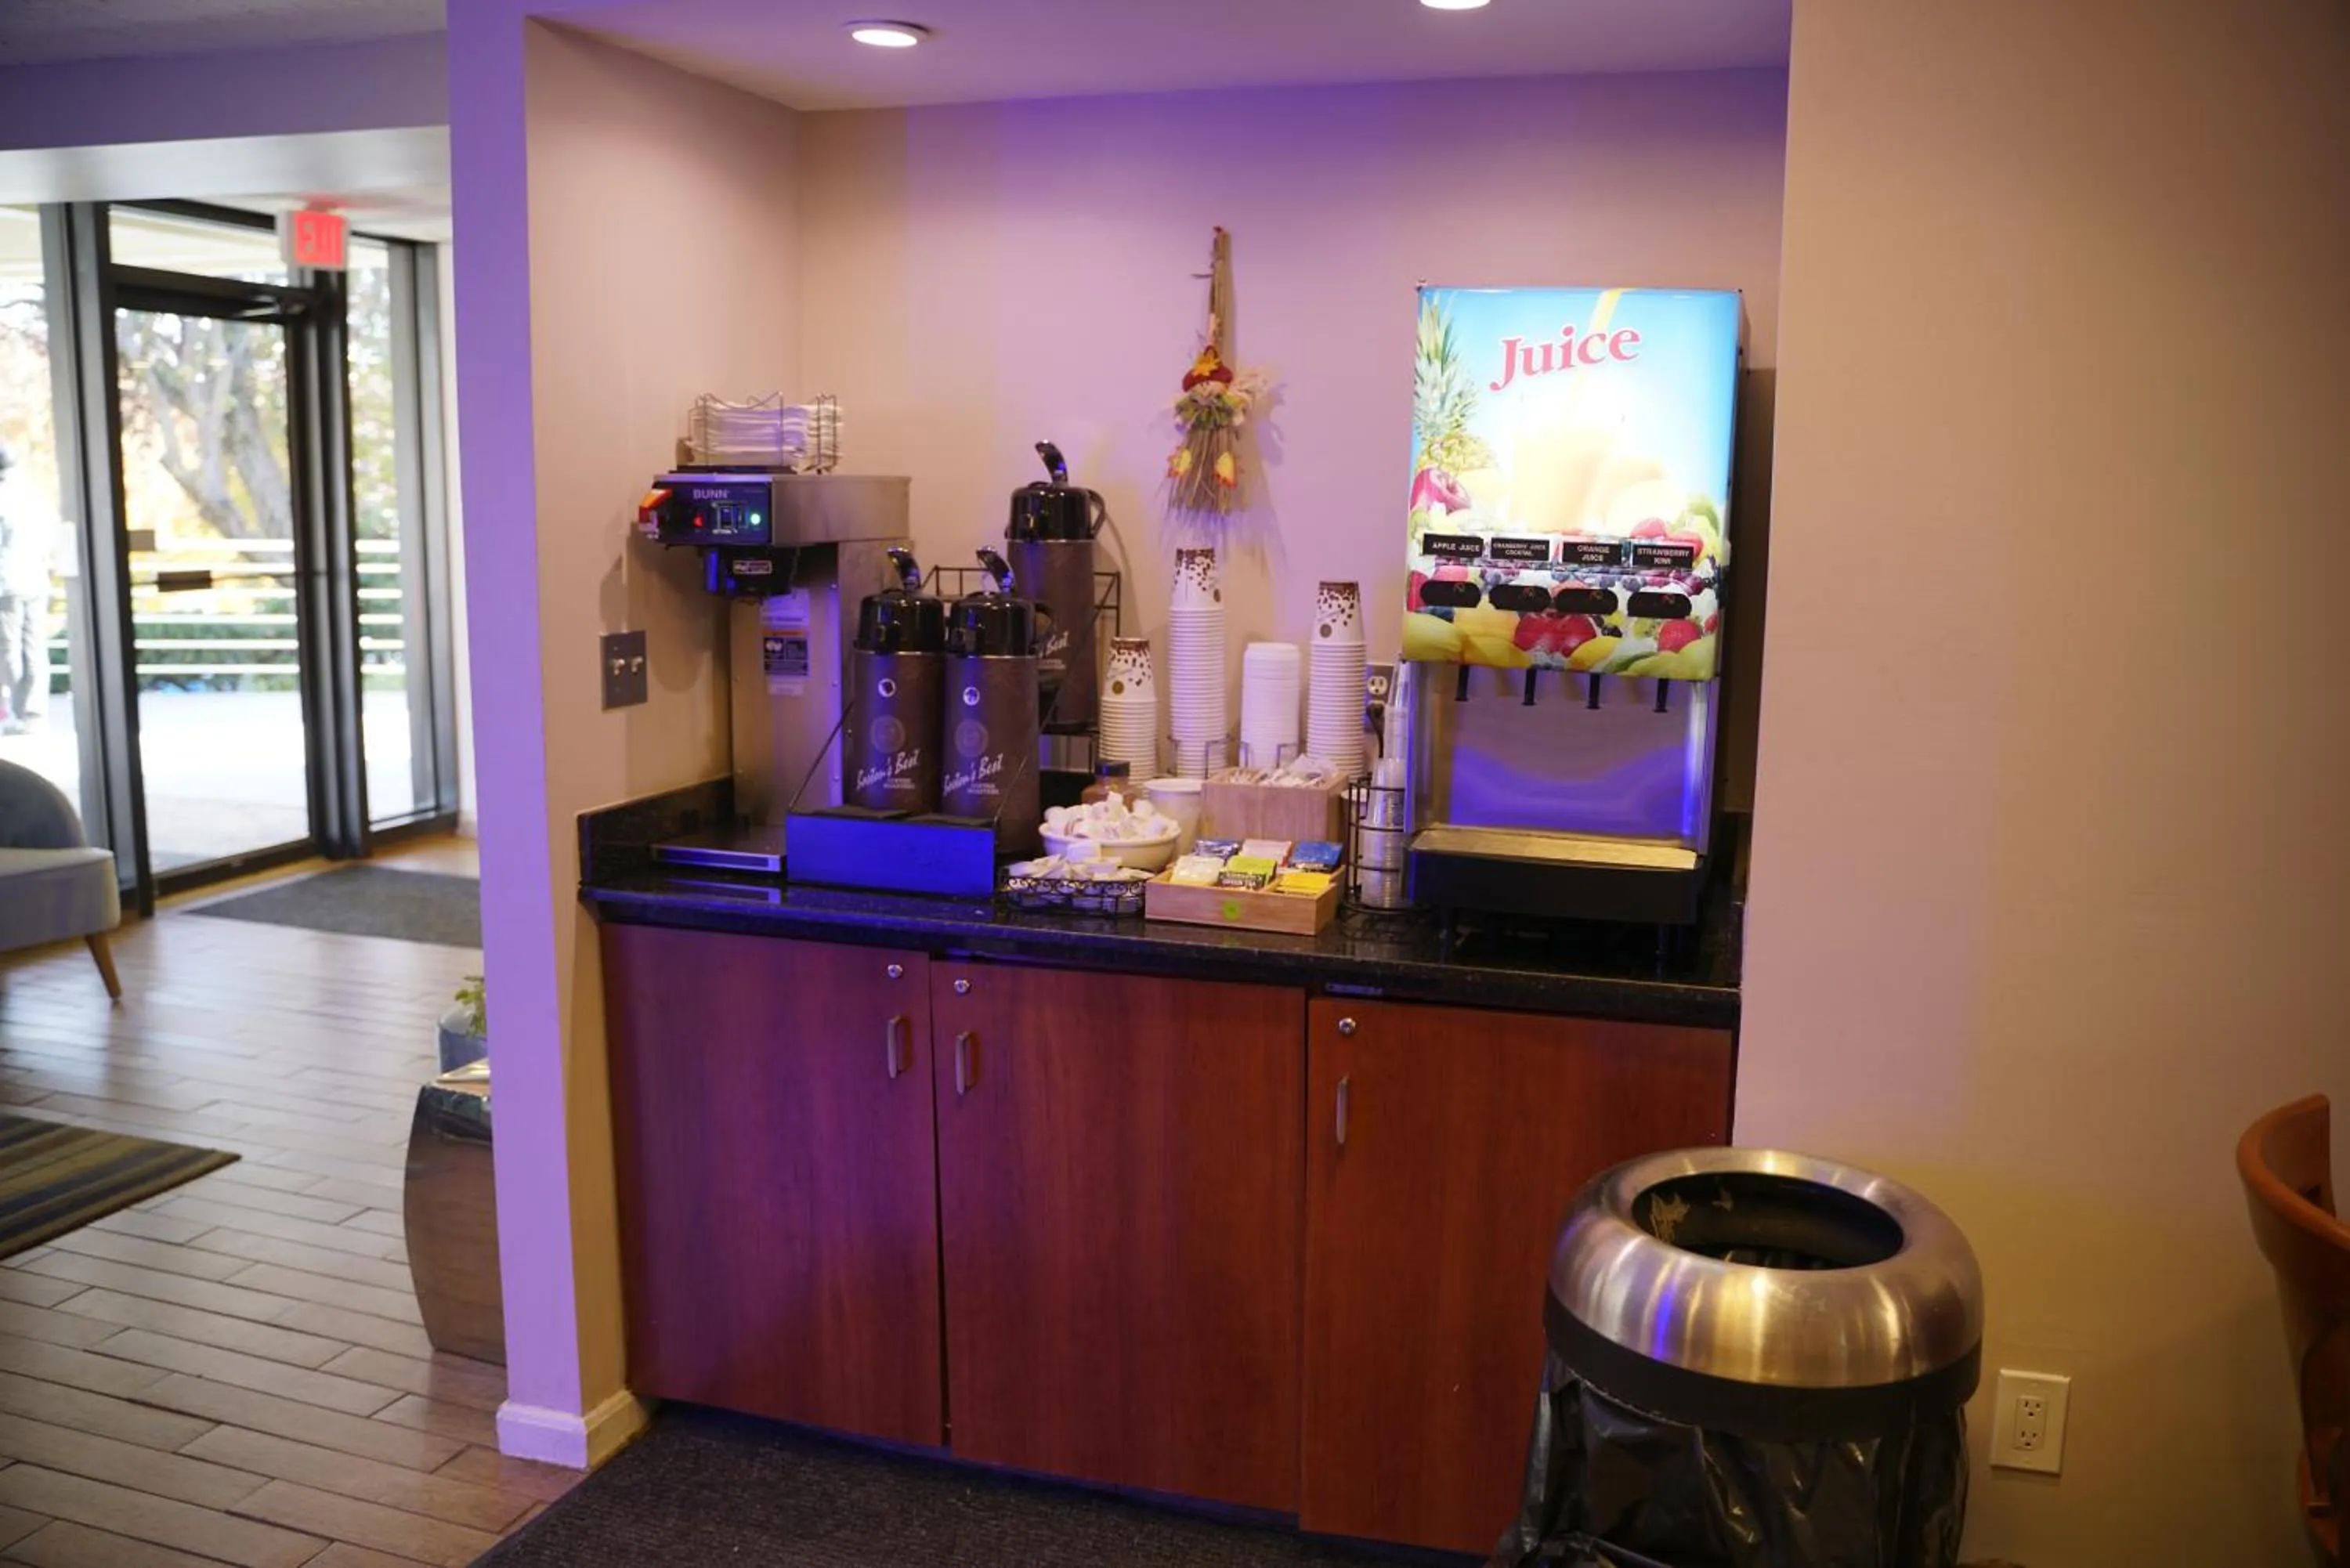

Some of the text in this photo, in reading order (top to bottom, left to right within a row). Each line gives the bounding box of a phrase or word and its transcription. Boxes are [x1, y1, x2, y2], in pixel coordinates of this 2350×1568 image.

[1489, 325, 1641, 392] Juice
[692, 489, 729, 500] BUNN
[1432, 541, 1480, 552] APPLE JUICE
[1576, 544, 1611, 554] ORANGE
[1636, 547, 1690, 558] STRAWBERRY
[1653, 557, 1672, 565] KIWI
[894, 748, 920, 775] Best
[978, 753, 1004, 780] Best
